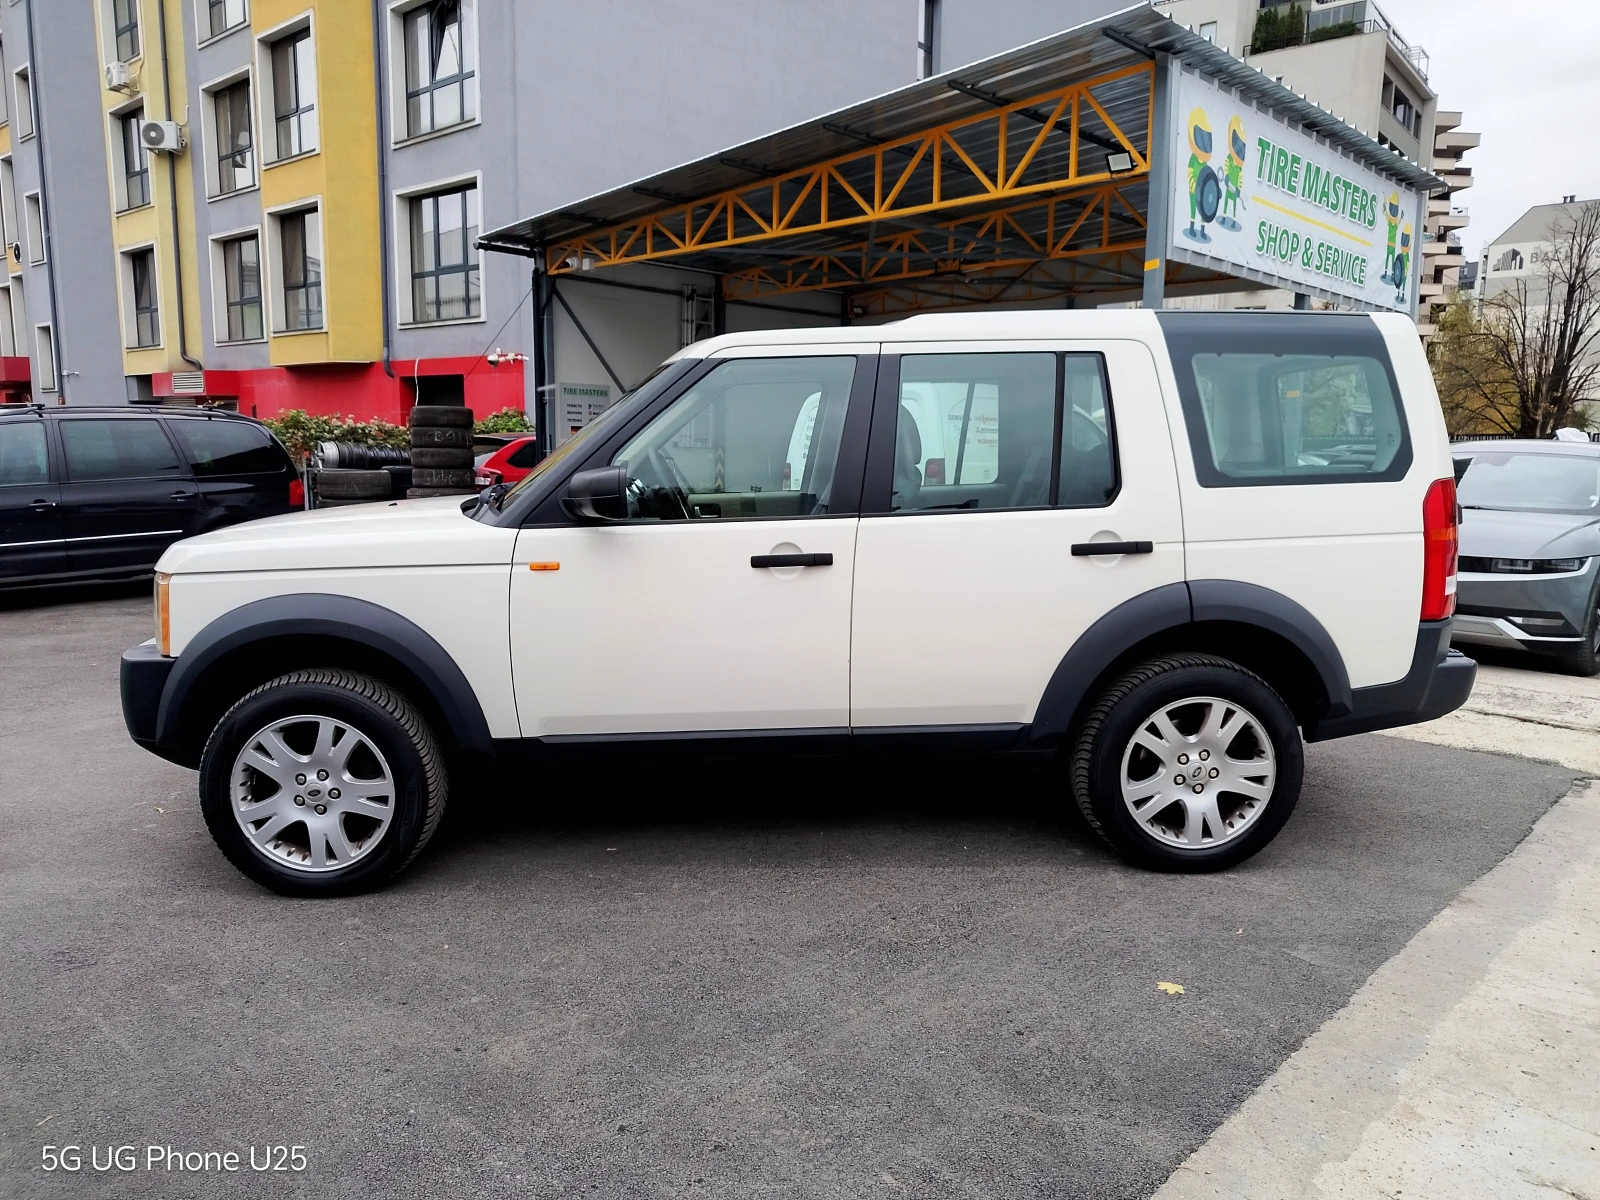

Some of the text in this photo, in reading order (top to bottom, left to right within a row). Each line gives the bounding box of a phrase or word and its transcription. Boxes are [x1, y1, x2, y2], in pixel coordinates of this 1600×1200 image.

[1256, 136, 1377, 228] TIRE MASTERS
[1255, 219, 1367, 286] SHOP & SERVICE
[563, 387, 609, 397] TIRE MASTERS
